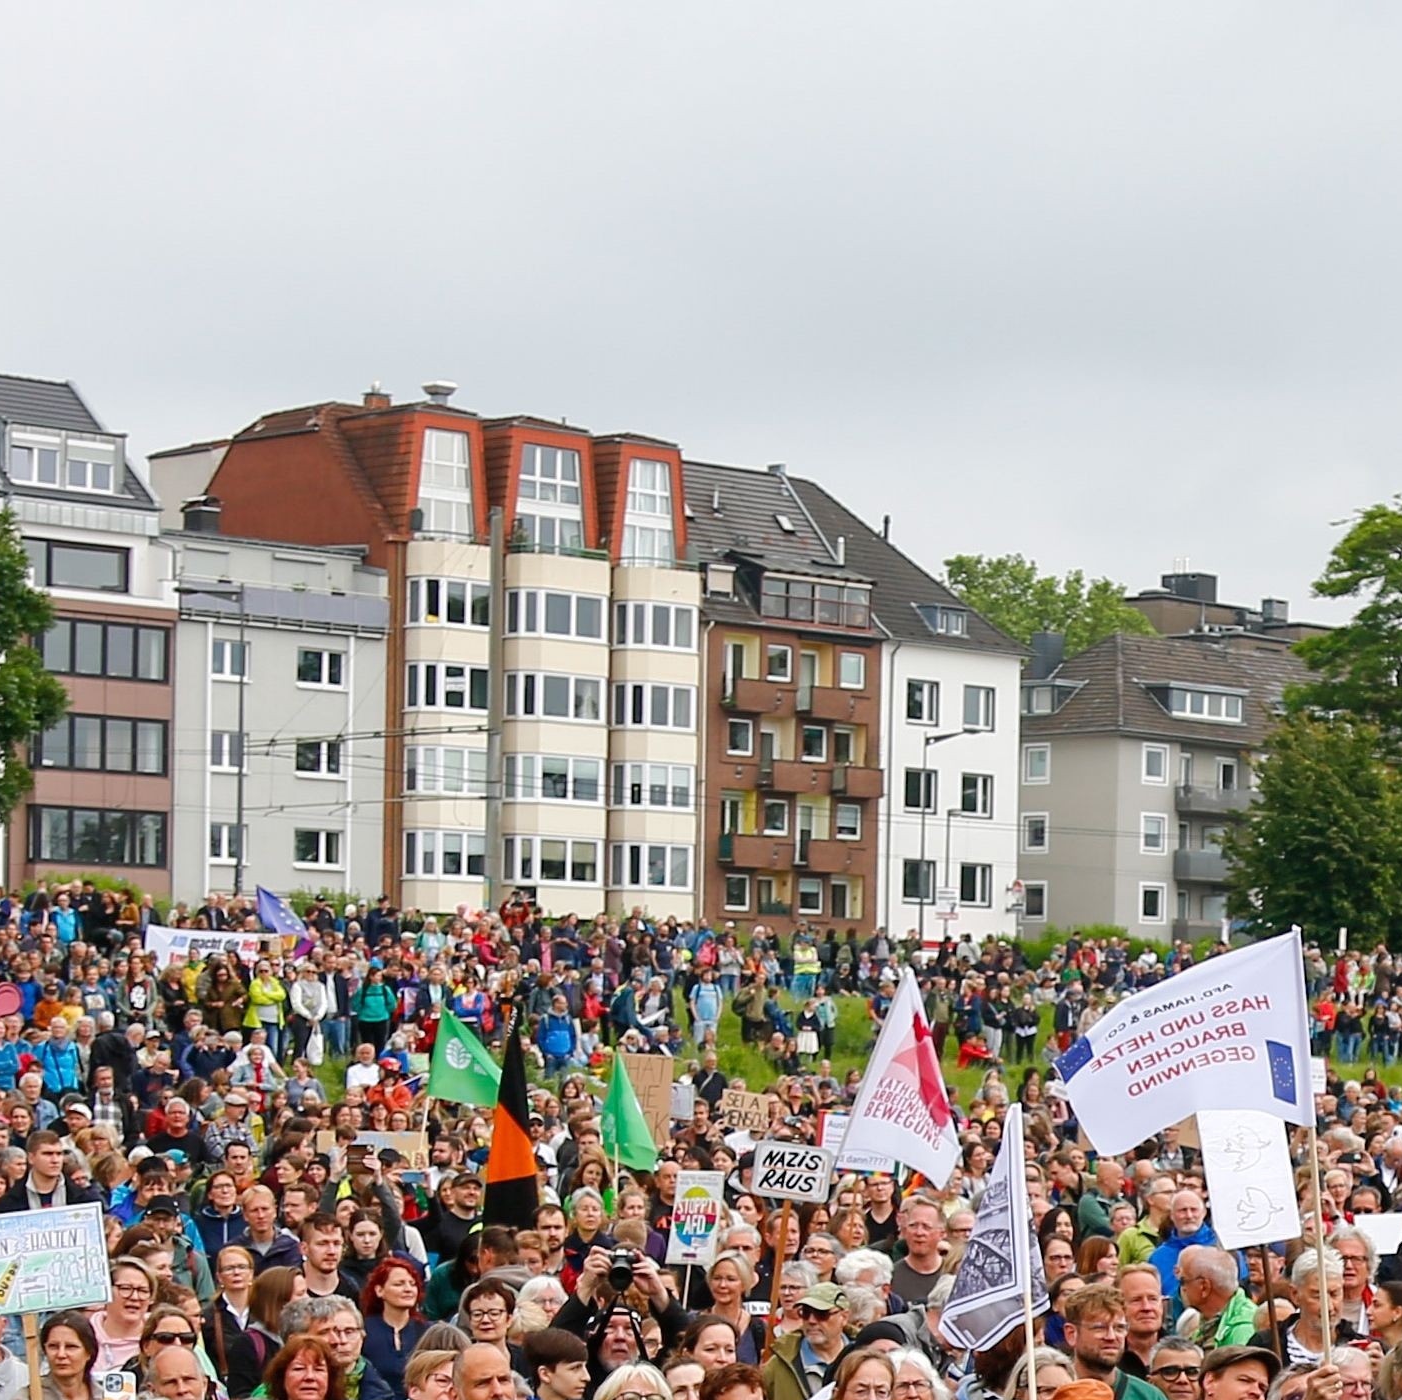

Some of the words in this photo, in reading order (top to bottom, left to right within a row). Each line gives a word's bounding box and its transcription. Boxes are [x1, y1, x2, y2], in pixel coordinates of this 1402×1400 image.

[726, 1092, 745, 1107] SEI
[863, 1101, 941, 1151] BEWEGUNG
[758, 1169, 816, 1193] RAUS
[30, 1228, 78, 1249] HALTEN
